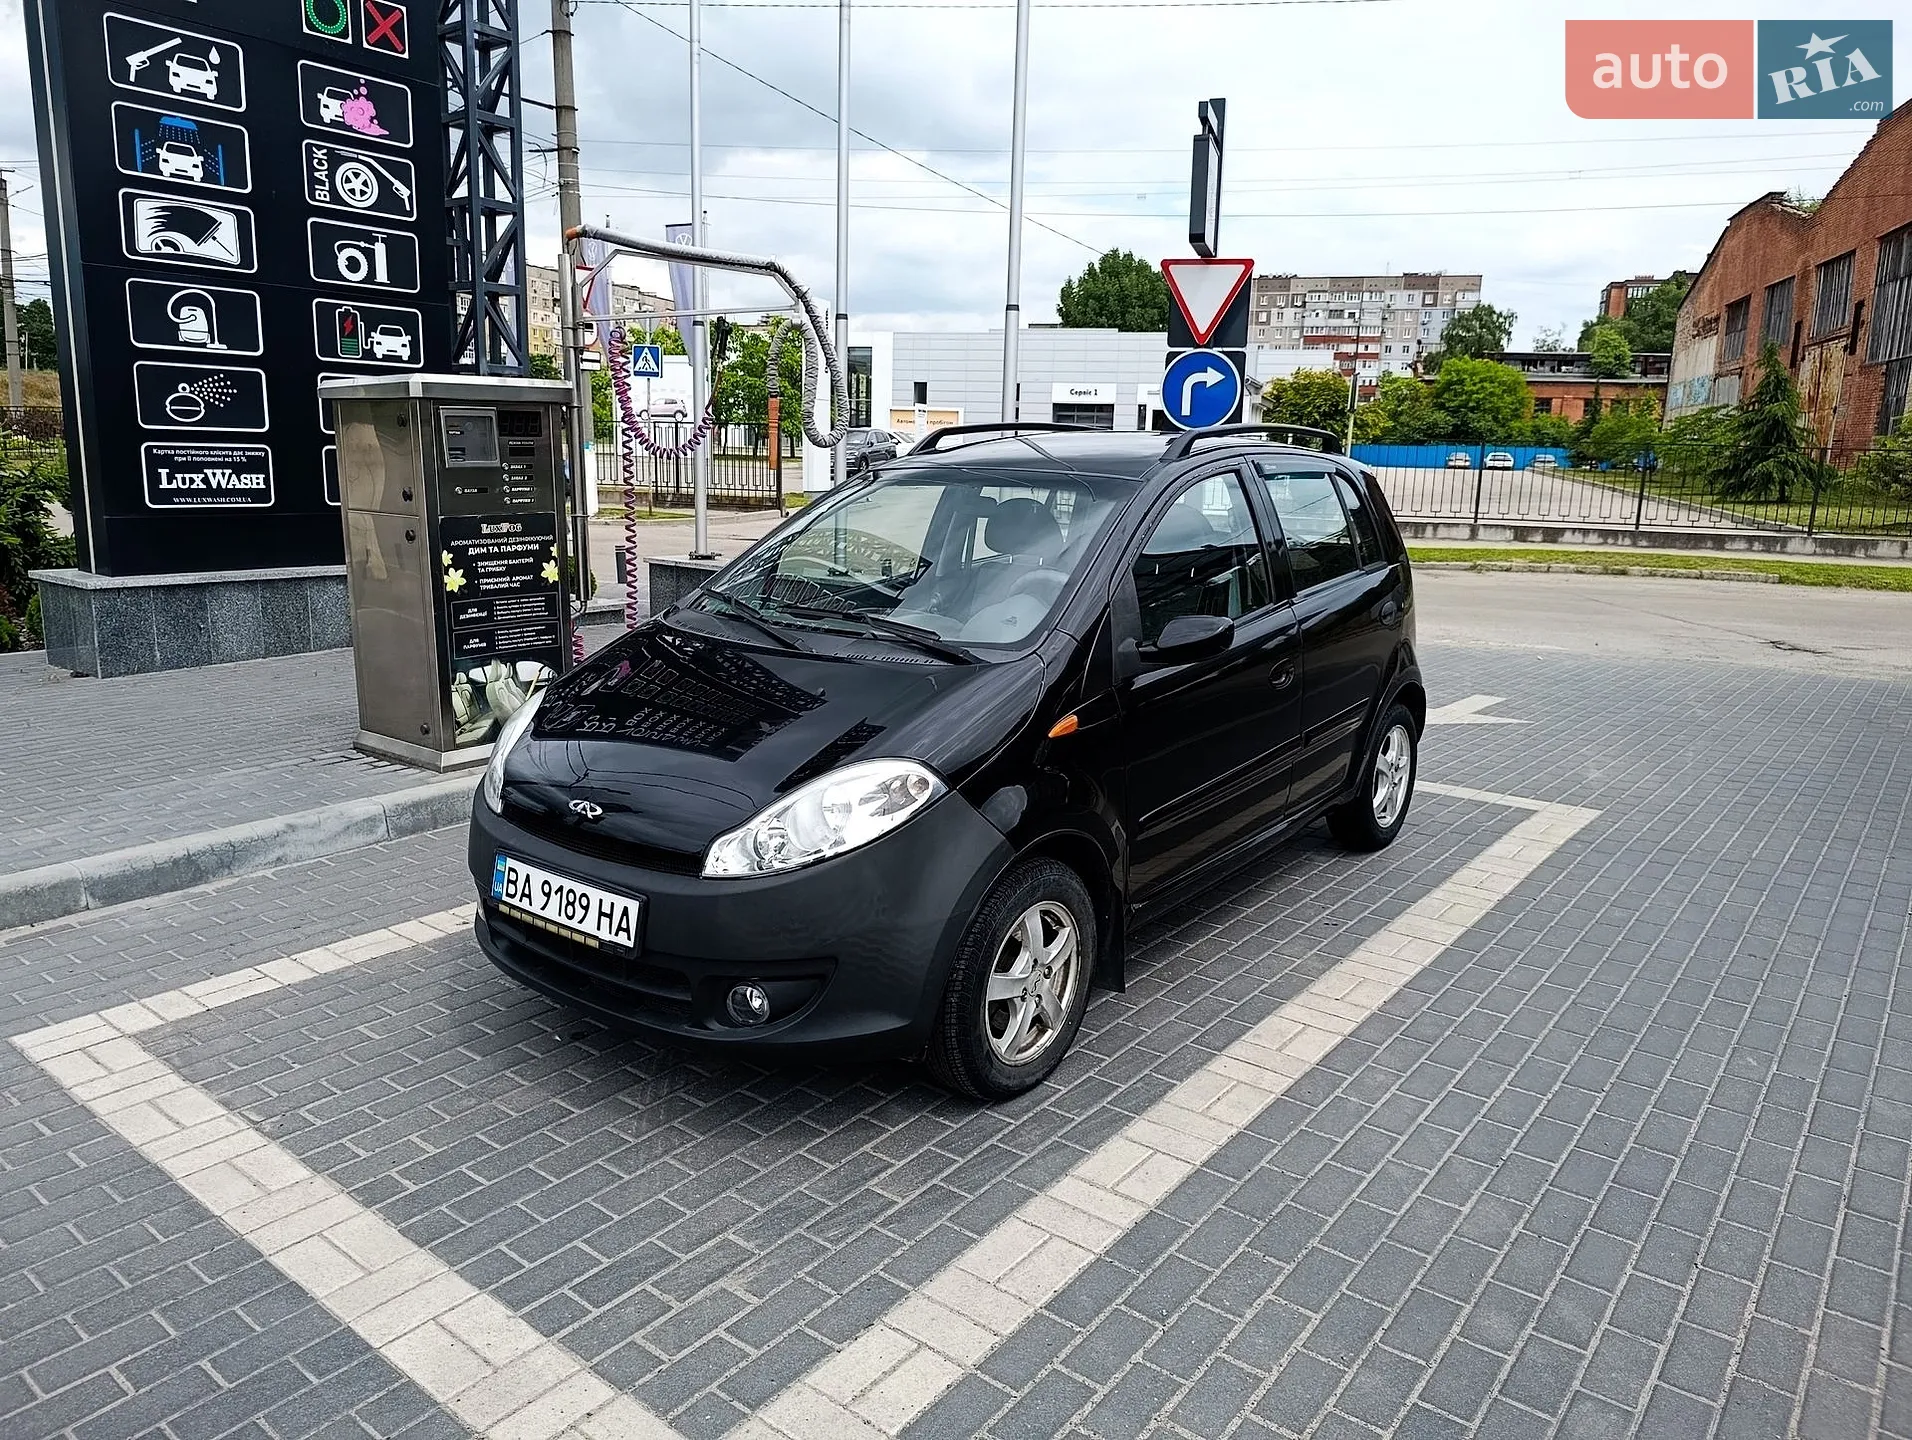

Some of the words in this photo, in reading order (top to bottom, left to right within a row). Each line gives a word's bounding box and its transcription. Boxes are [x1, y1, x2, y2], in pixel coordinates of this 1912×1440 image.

[312, 146, 331, 202] BLACK
[1069, 388, 1092, 397] Сервіс
[152, 448, 175, 456] Картка
[468, 546, 488, 556] ДИМ
[500, 543, 540, 553] ПАРФУМИ
[477, 559, 509, 567] ЗНИЩЕННЯ
[494, 881, 504, 893] UA
[505, 866, 533, 907] BA
[539, 879, 591, 925] 9189
[596, 898, 632, 942] HA
